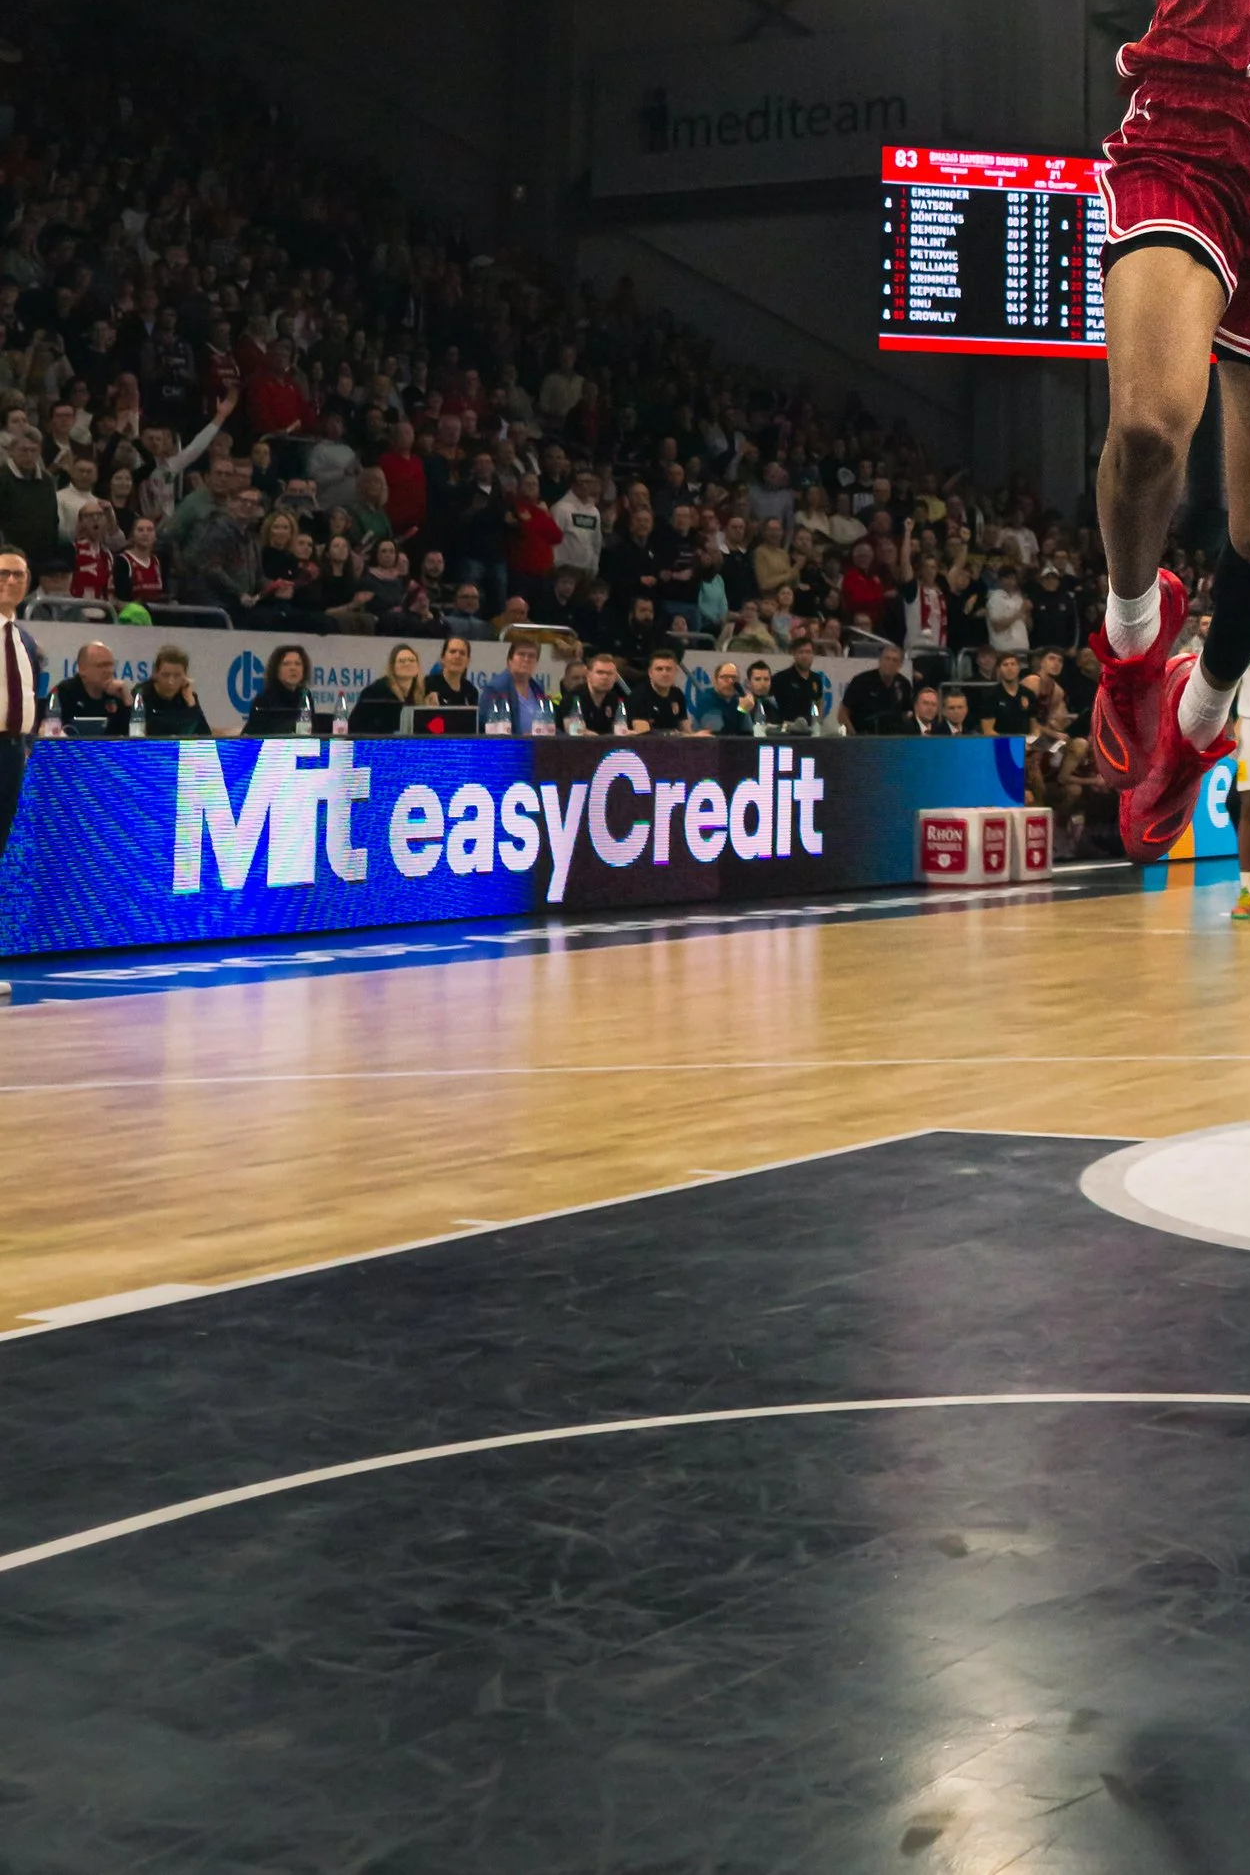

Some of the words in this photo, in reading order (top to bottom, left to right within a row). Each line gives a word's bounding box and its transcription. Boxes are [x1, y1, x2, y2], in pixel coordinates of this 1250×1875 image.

[671, 94, 909, 151] mediteam
[894, 149, 918, 168] 83
[911, 187, 970, 201] ENSMINGER
[1020, 192, 1028, 204] P
[1042, 193, 1049, 205] F
[910, 198, 953, 212] WATSON
[1020, 204, 1028, 216] P
[1042, 206, 1049, 217] F
[1020, 216, 1028, 228] P
[1042, 218, 1049, 229] F
[910, 223, 957, 237] DEMONIA
[1020, 229, 1028, 240] P
[1042, 230, 1049, 241] F
[910, 235, 947, 248] BALINT
[1020, 241, 1028, 252] P
[1042, 243, 1049, 253] F
[910, 248, 959, 262] PETKOVIC
[1020, 253, 1028, 264] P
[1042, 254, 1049, 265] F
[910, 260, 959, 273] WILLIAMS
[1020, 266, 1028, 277] P
[1042, 267, 1049, 278] F
[909, 273, 957, 285] KRIMMER
[1020, 278, 1028, 288] P
[1042, 279, 1049, 290] F
[909, 285, 962, 298] KEPPELER
[1020, 290, 1028, 301] P
[1042, 291, 1049, 302] F
[909, 298, 932, 309] ONU
[1020, 302, 1028, 313] P
[1042, 303, 1049, 314] F
[909, 309, 957, 323] CROWLEY
[1020, 315, 1028, 326] P
[1042, 315, 1049, 327] F
[313, 666, 371, 687] RASHI
[388, 745, 824, 904] easyCredit
